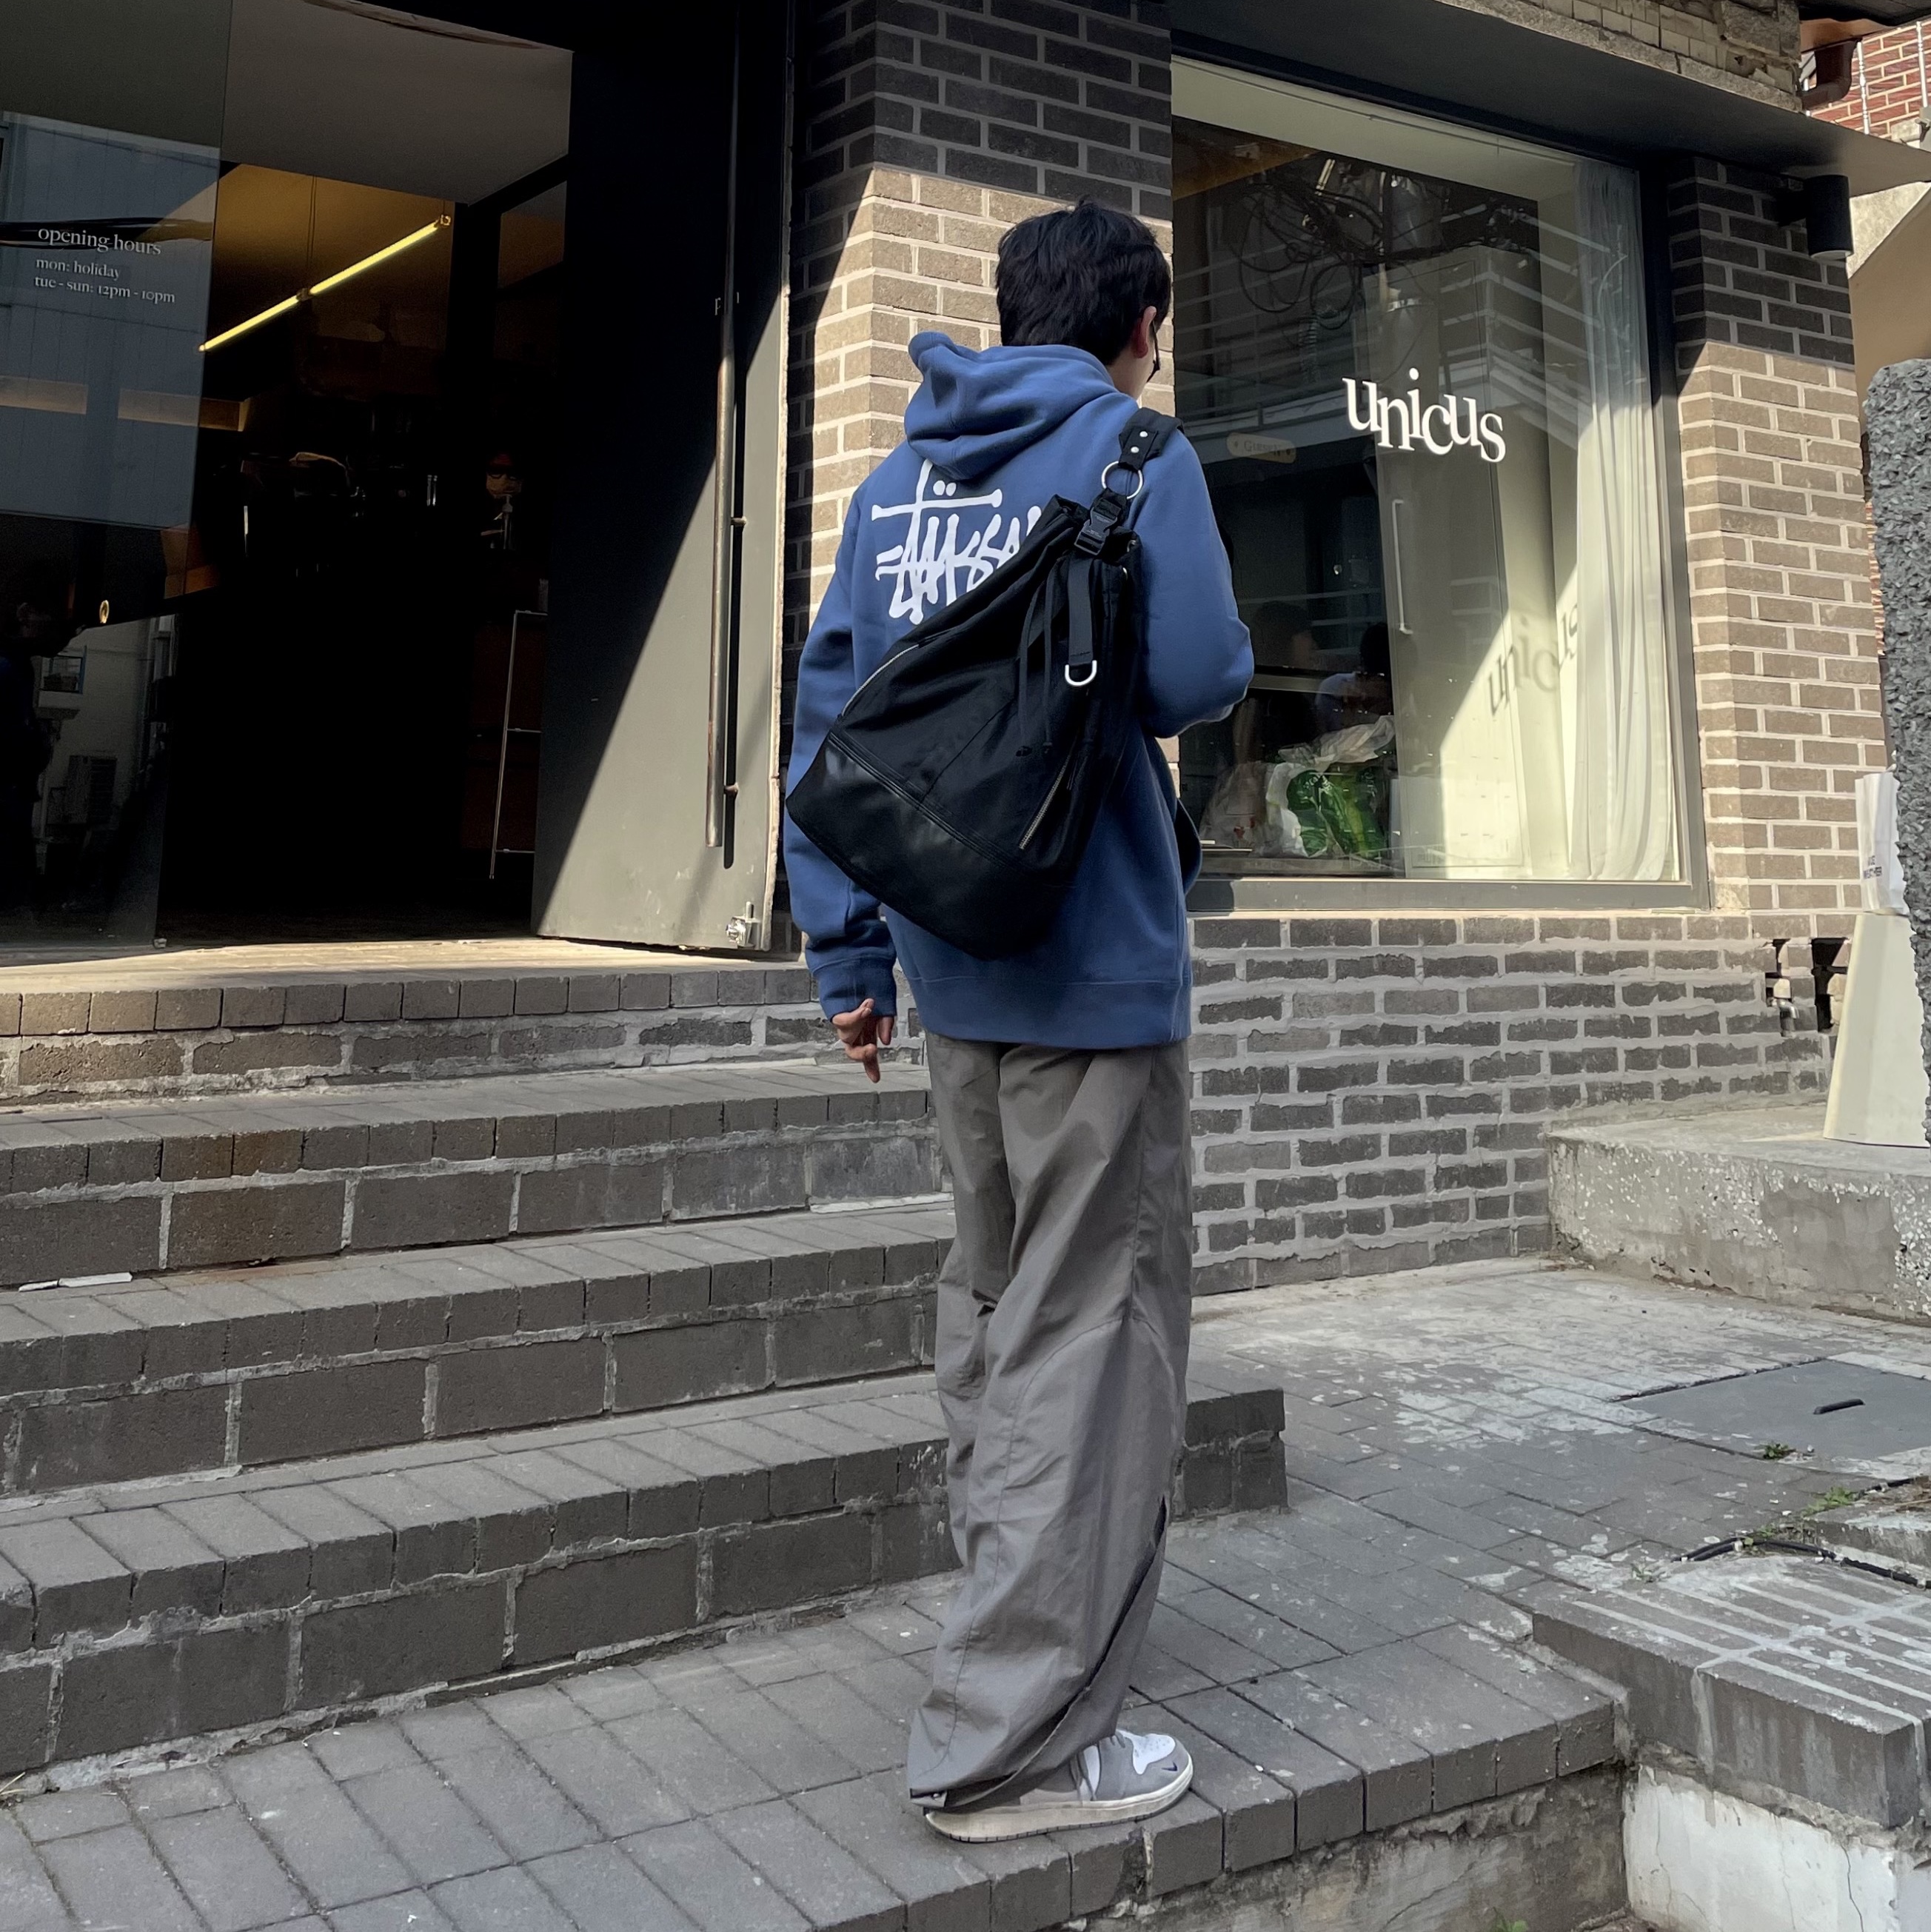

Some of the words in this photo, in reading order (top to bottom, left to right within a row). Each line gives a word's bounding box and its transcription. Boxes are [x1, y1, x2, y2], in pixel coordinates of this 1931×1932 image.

[38, 227, 110, 253] opening
[113, 233, 161, 255] hours
[36, 259, 70, 272] mon:
[73, 261, 120, 281] holiday
[35, 276, 56, 288] tue
[67, 281, 93, 293] sun:
[98, 285, 130, 298] 12pm
[141, 290, 175, 304] 10pm
[1342, 368, 1506, 463] unicus
